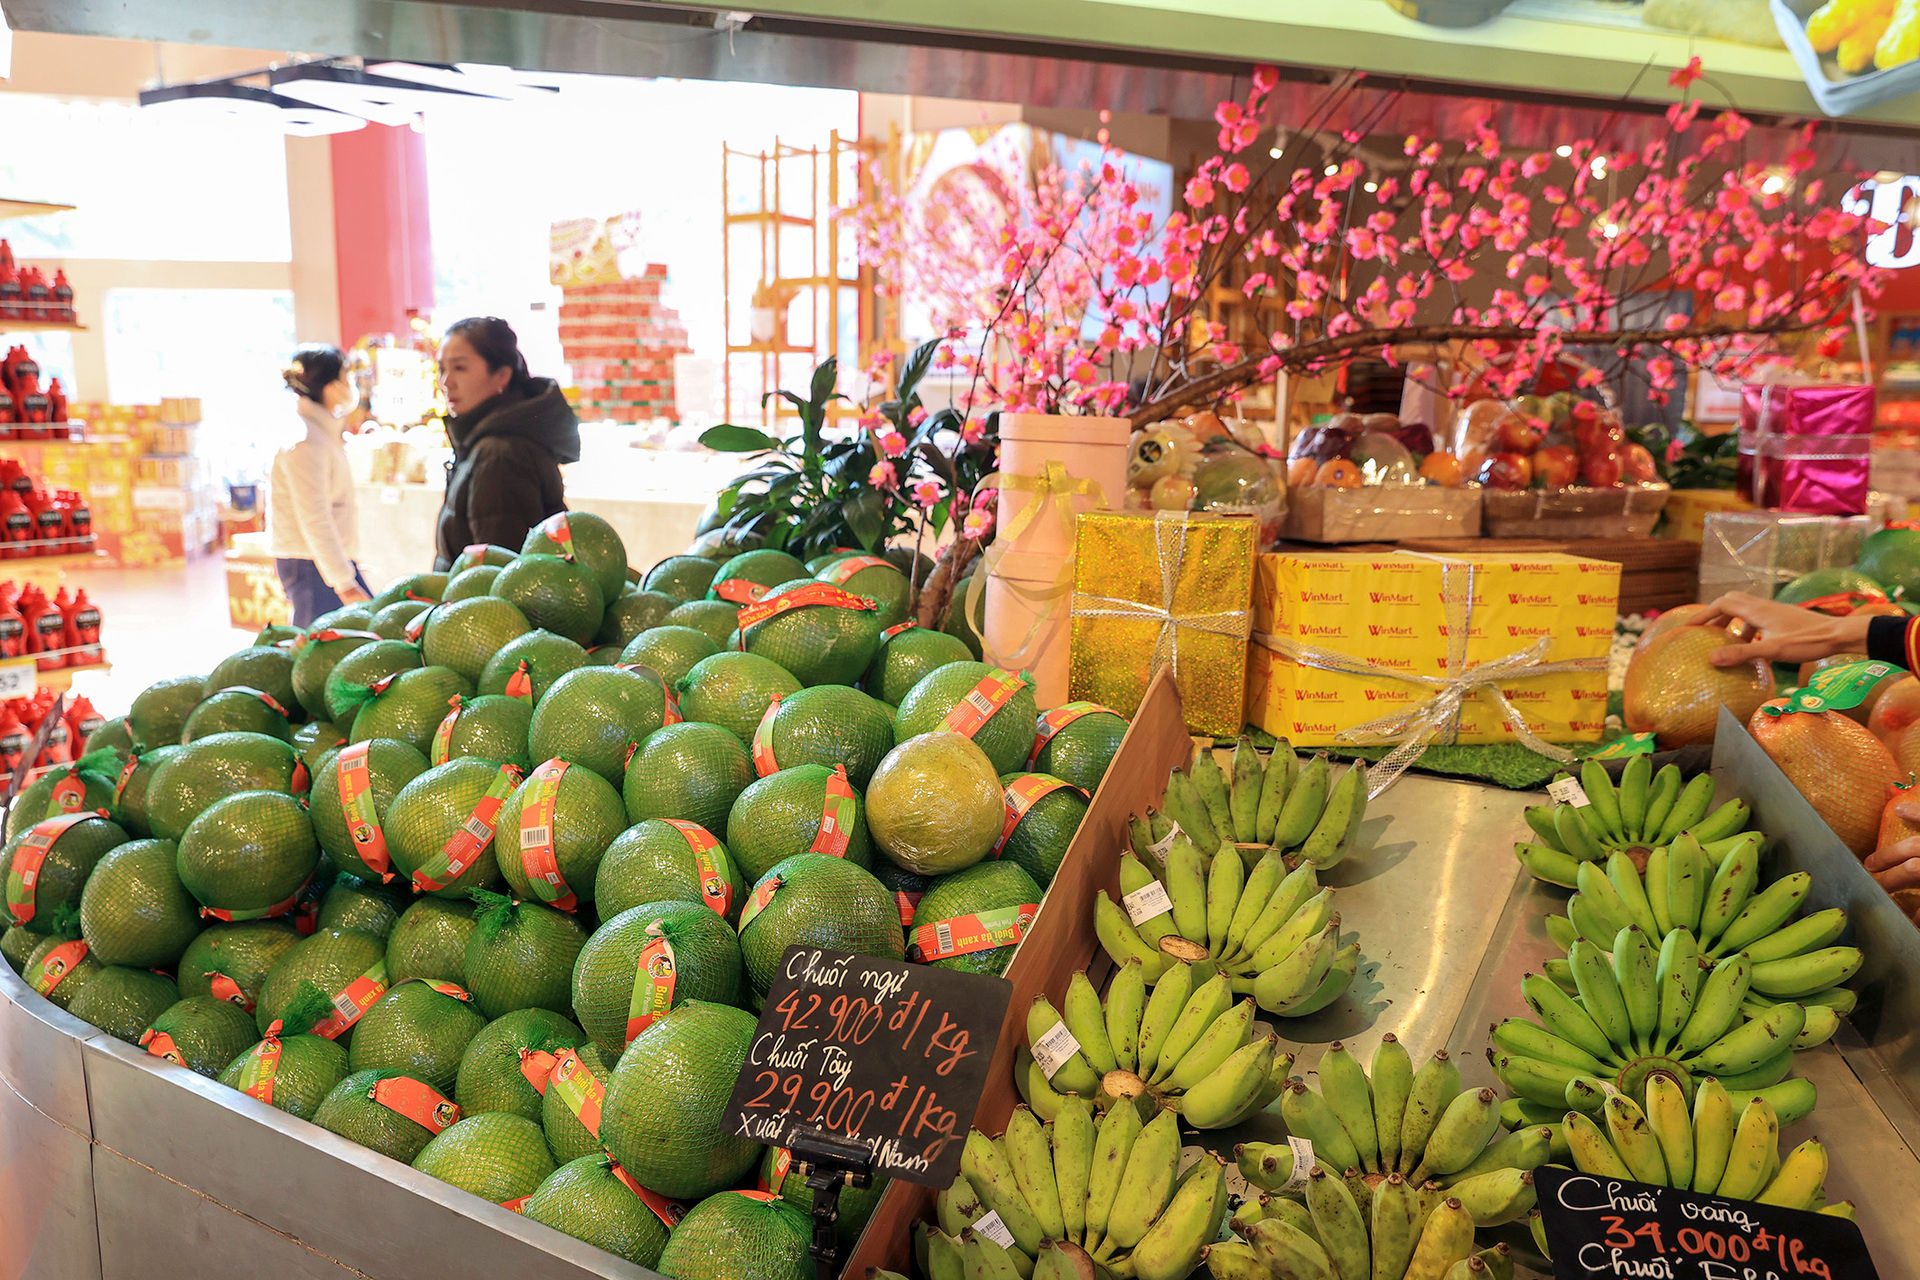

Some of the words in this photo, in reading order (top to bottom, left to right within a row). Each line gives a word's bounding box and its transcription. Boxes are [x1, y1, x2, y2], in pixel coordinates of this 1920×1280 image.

[1301, 591, 1343, 602] WinMart
[1370, 592, 1414, 603] WinMart
[1508, 593, 1552, 605] WinMart
[1299, 624, 1342, 635] WinMart
[1368, 625, 1413, 636] WinMart
[1508, 626, 1551, 637] WinMart
[1295, 690, 1338, 701] WinMart
[1365, 689, 1409, 701] WinMart
[1503, 690, 1546, 700] WinMart
[1293, 722, 1336, 733] WinMart
[957, 935, 979, 948] xanh
[787, 950, 854, 989] Chuối
[751, 1032, 818, 1069] Chuối
[734, 1109, 790, 1139] Xuất
[1557, 1176, 1662, 1213] Chuối
[1578, 1242, 1683, 1280] Chuối
